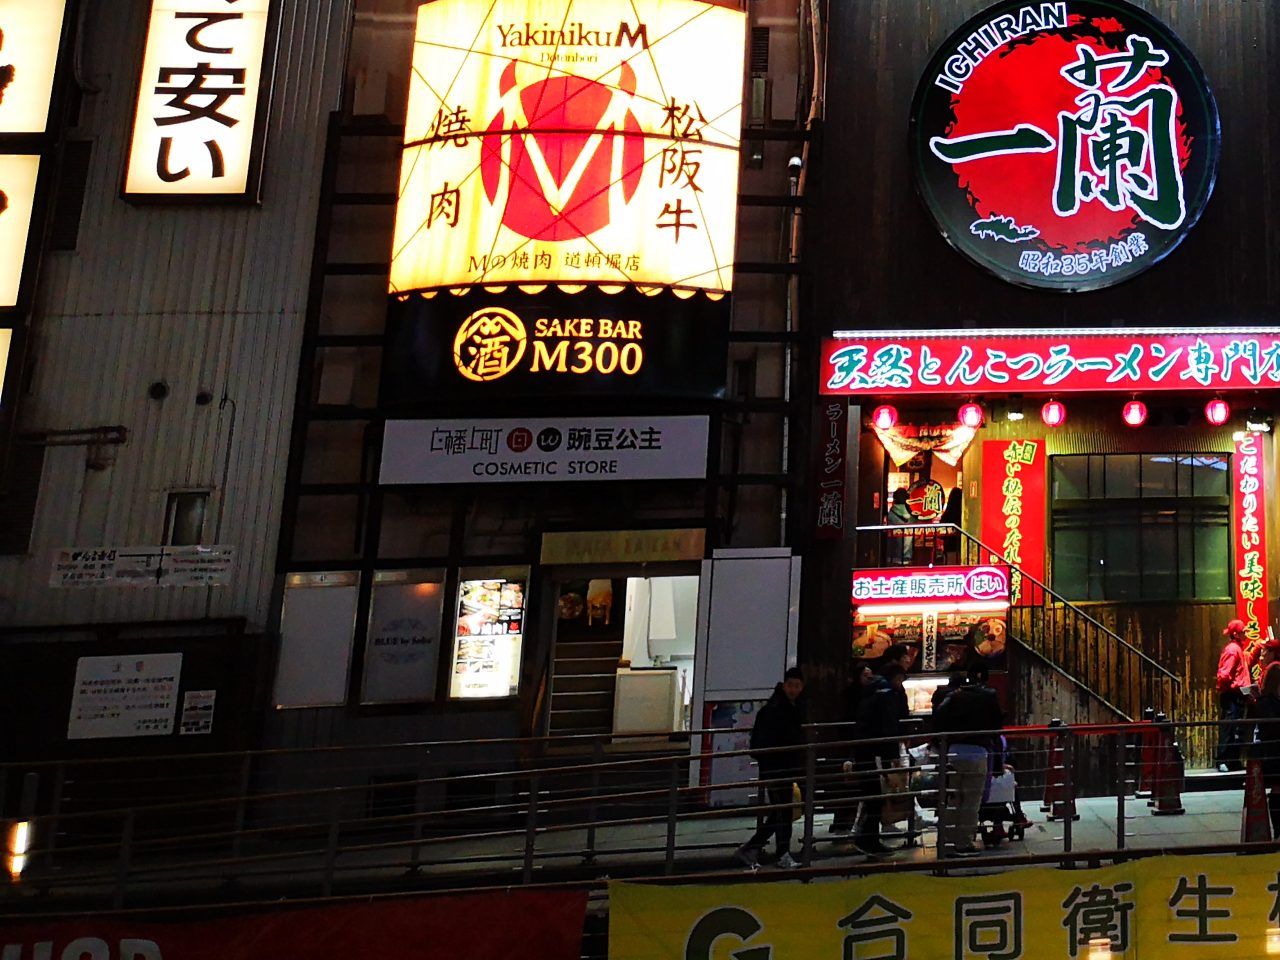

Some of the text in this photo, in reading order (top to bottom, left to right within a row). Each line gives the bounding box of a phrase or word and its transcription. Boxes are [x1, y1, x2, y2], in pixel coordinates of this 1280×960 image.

[497, 24, 614, 48] Yakiniku
[935, 2, 1068, 93] ICHIRAN
[929, 34, 1186, 230] 一蘭
[427, 105, 472, 230] 焼肉
[656, 97, 708, 244] 松阪牛
[1019, 233, 1150, 276] 昭和35年創業
[535, 318, 643, 339] SAKE BAR
[530, 341, 643, 375] M300
[472, 460, 618, 476] COSMETIC STORE
[853, 576, 1002, 597] お土産販売所 はい
